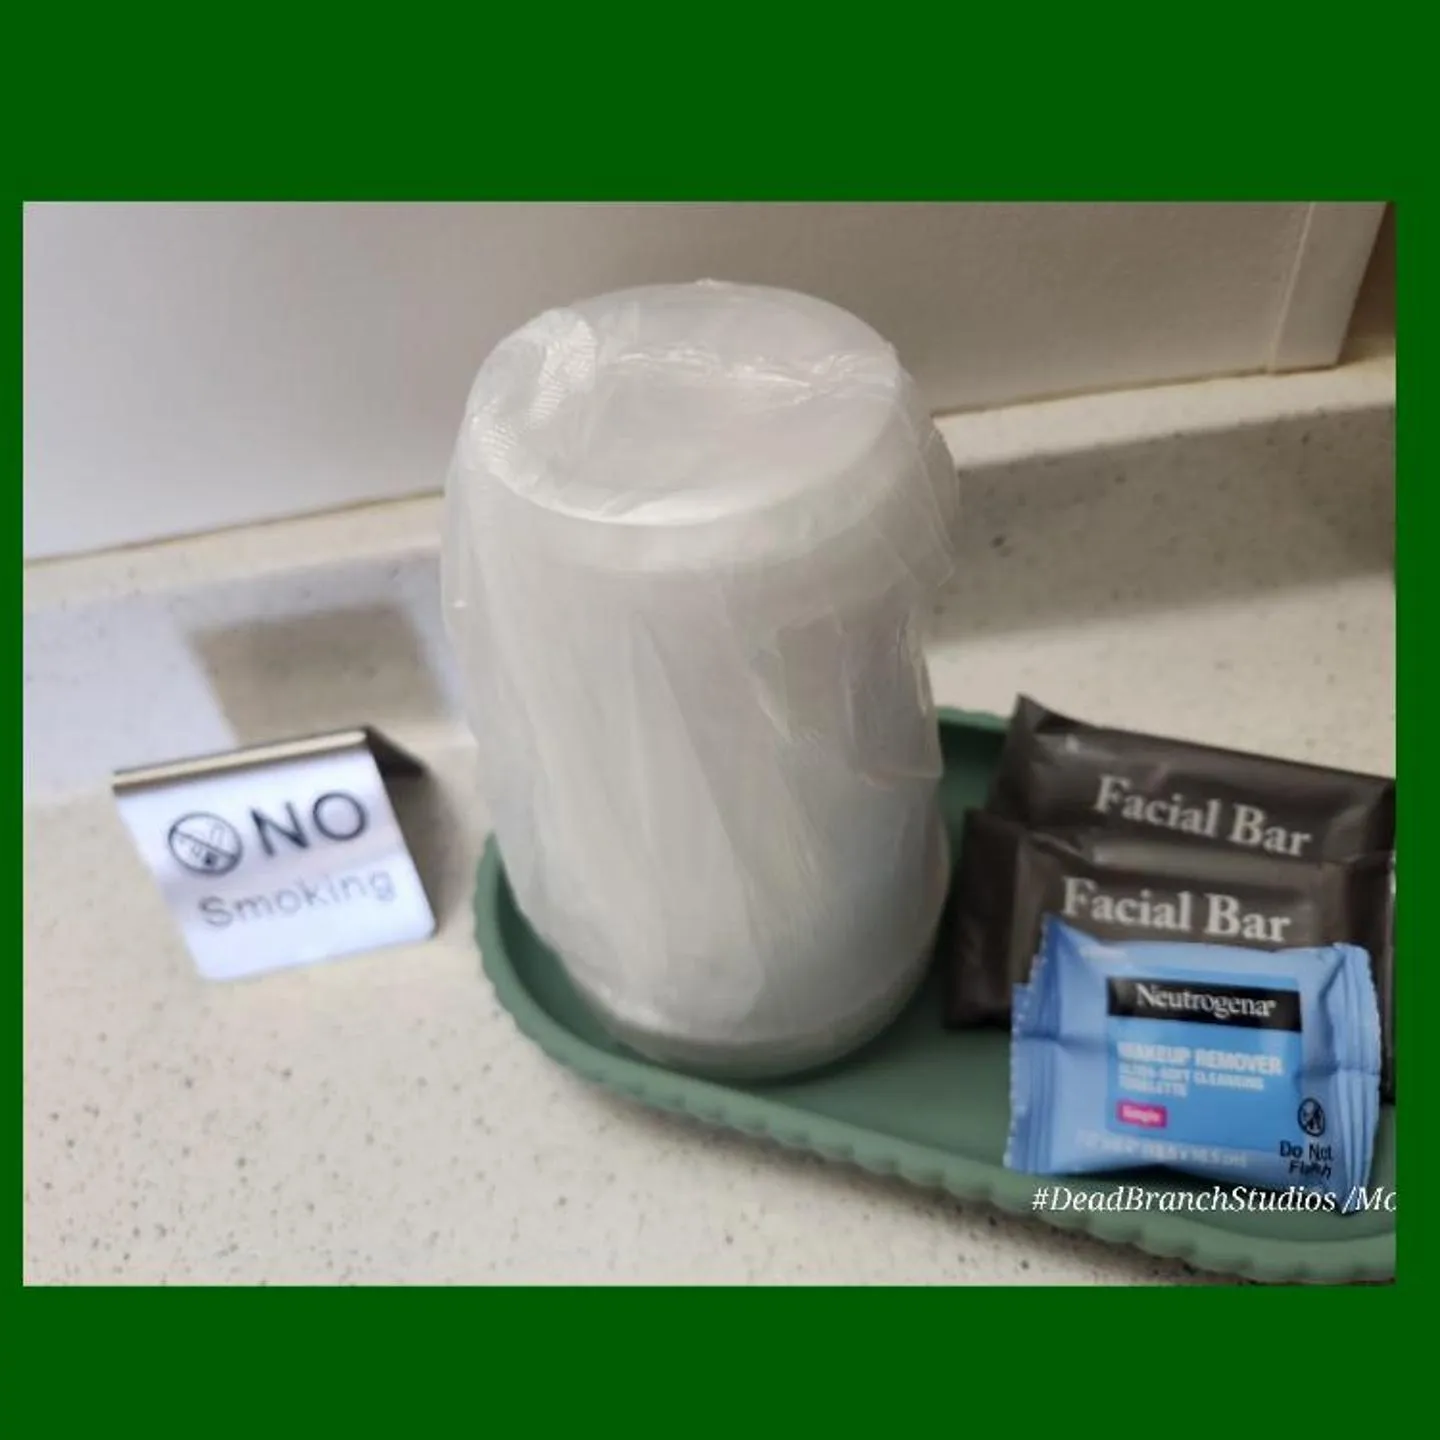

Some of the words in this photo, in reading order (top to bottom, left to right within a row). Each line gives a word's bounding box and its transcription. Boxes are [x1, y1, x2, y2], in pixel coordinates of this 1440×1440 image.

[250, 792, 366, 857] NO
[1094, 773, 1218, 838] Facial
[1230, 802, 1314, 857] Bar
[199, 871, 395, 926] Smoking
[1062, 876, 1194, 932] Facial
[1203, 892, 1292, 943] Bar
[1194, 1048, 1285, 1077] REMOVER
[1279, 1140, 1304, 1159] Do
